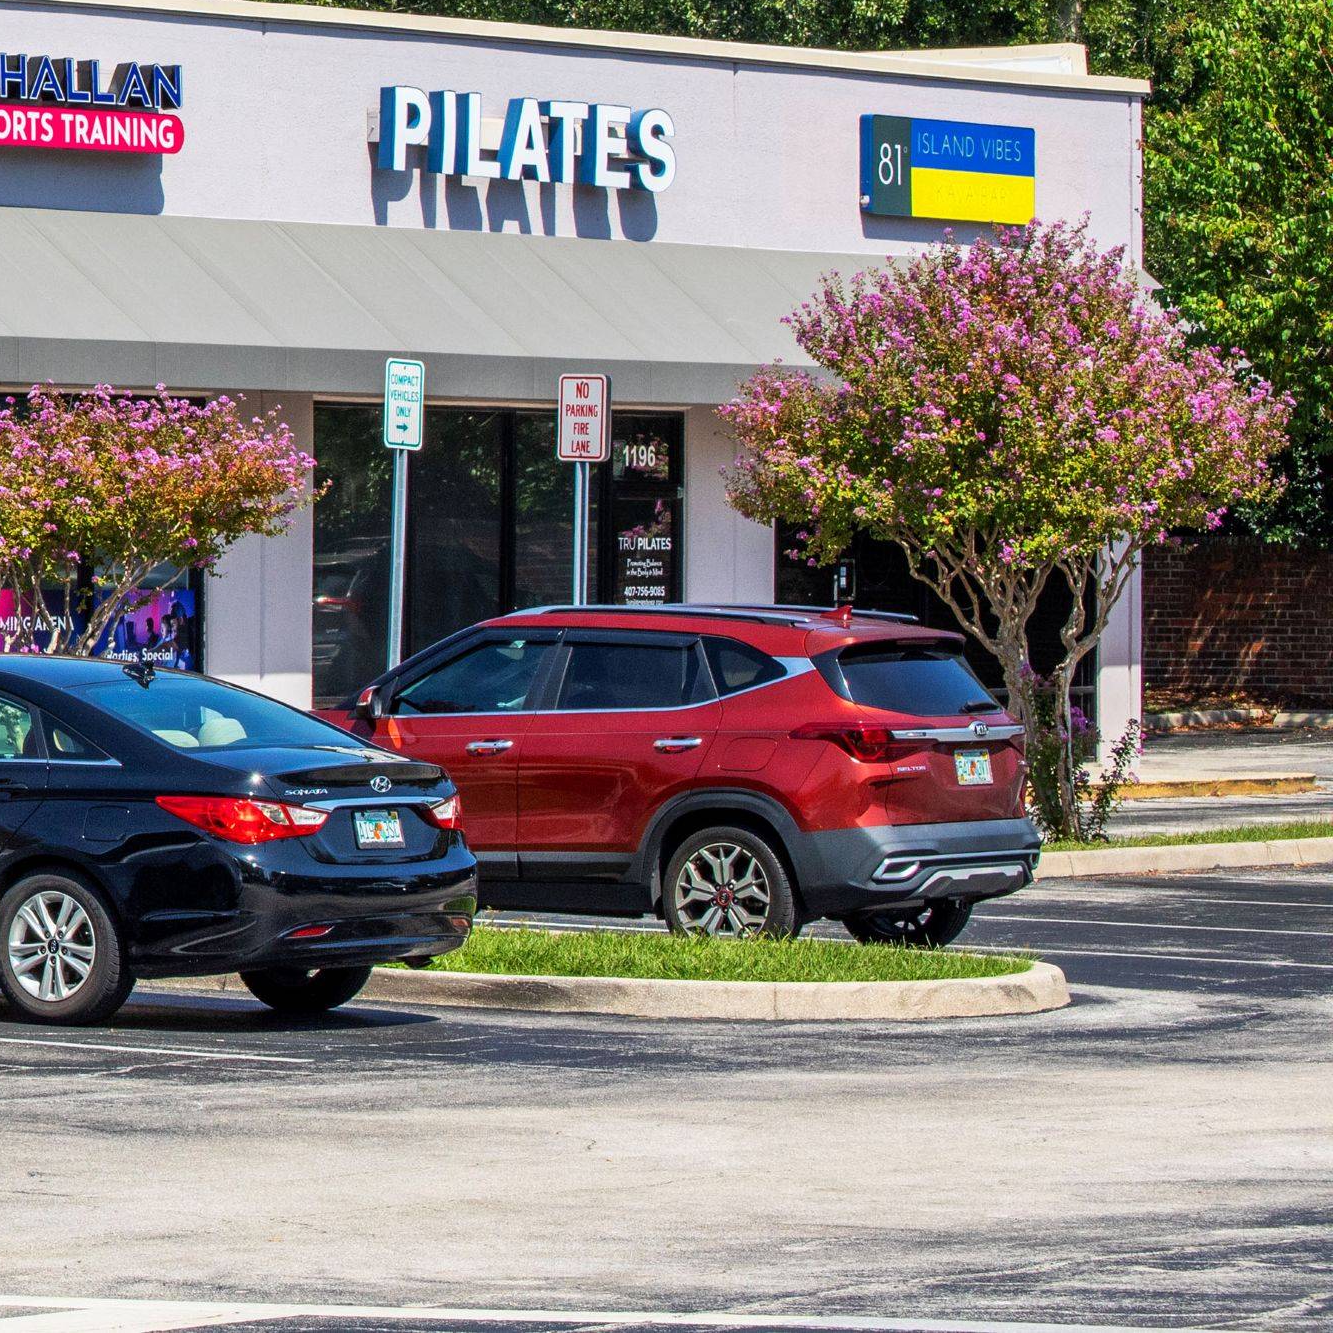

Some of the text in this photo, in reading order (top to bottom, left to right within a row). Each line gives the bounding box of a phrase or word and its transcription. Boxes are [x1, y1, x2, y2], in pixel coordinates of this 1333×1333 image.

[60, 112, 176, 154] TRAINING
[378, 84, 678, 194] PILATES
[917, 132, 1022, 162] ISLAND VIBES
[390, 374, 419, 386] COMPACT
[390, 389, 419, 403] VEHICLES
[576, 382, 590, 399] NO
[396, 405, 411, 417] ONLY
[565, 404, 598, 417] PARKING
[573, 422, 590, 435] FIRE
[571, 440, 590, 453] LANE
[623, 445, 656, 466] 1196
[618, 537, 672, 551] TRU PILATES
[283, 788, 329, 796] SONATA
